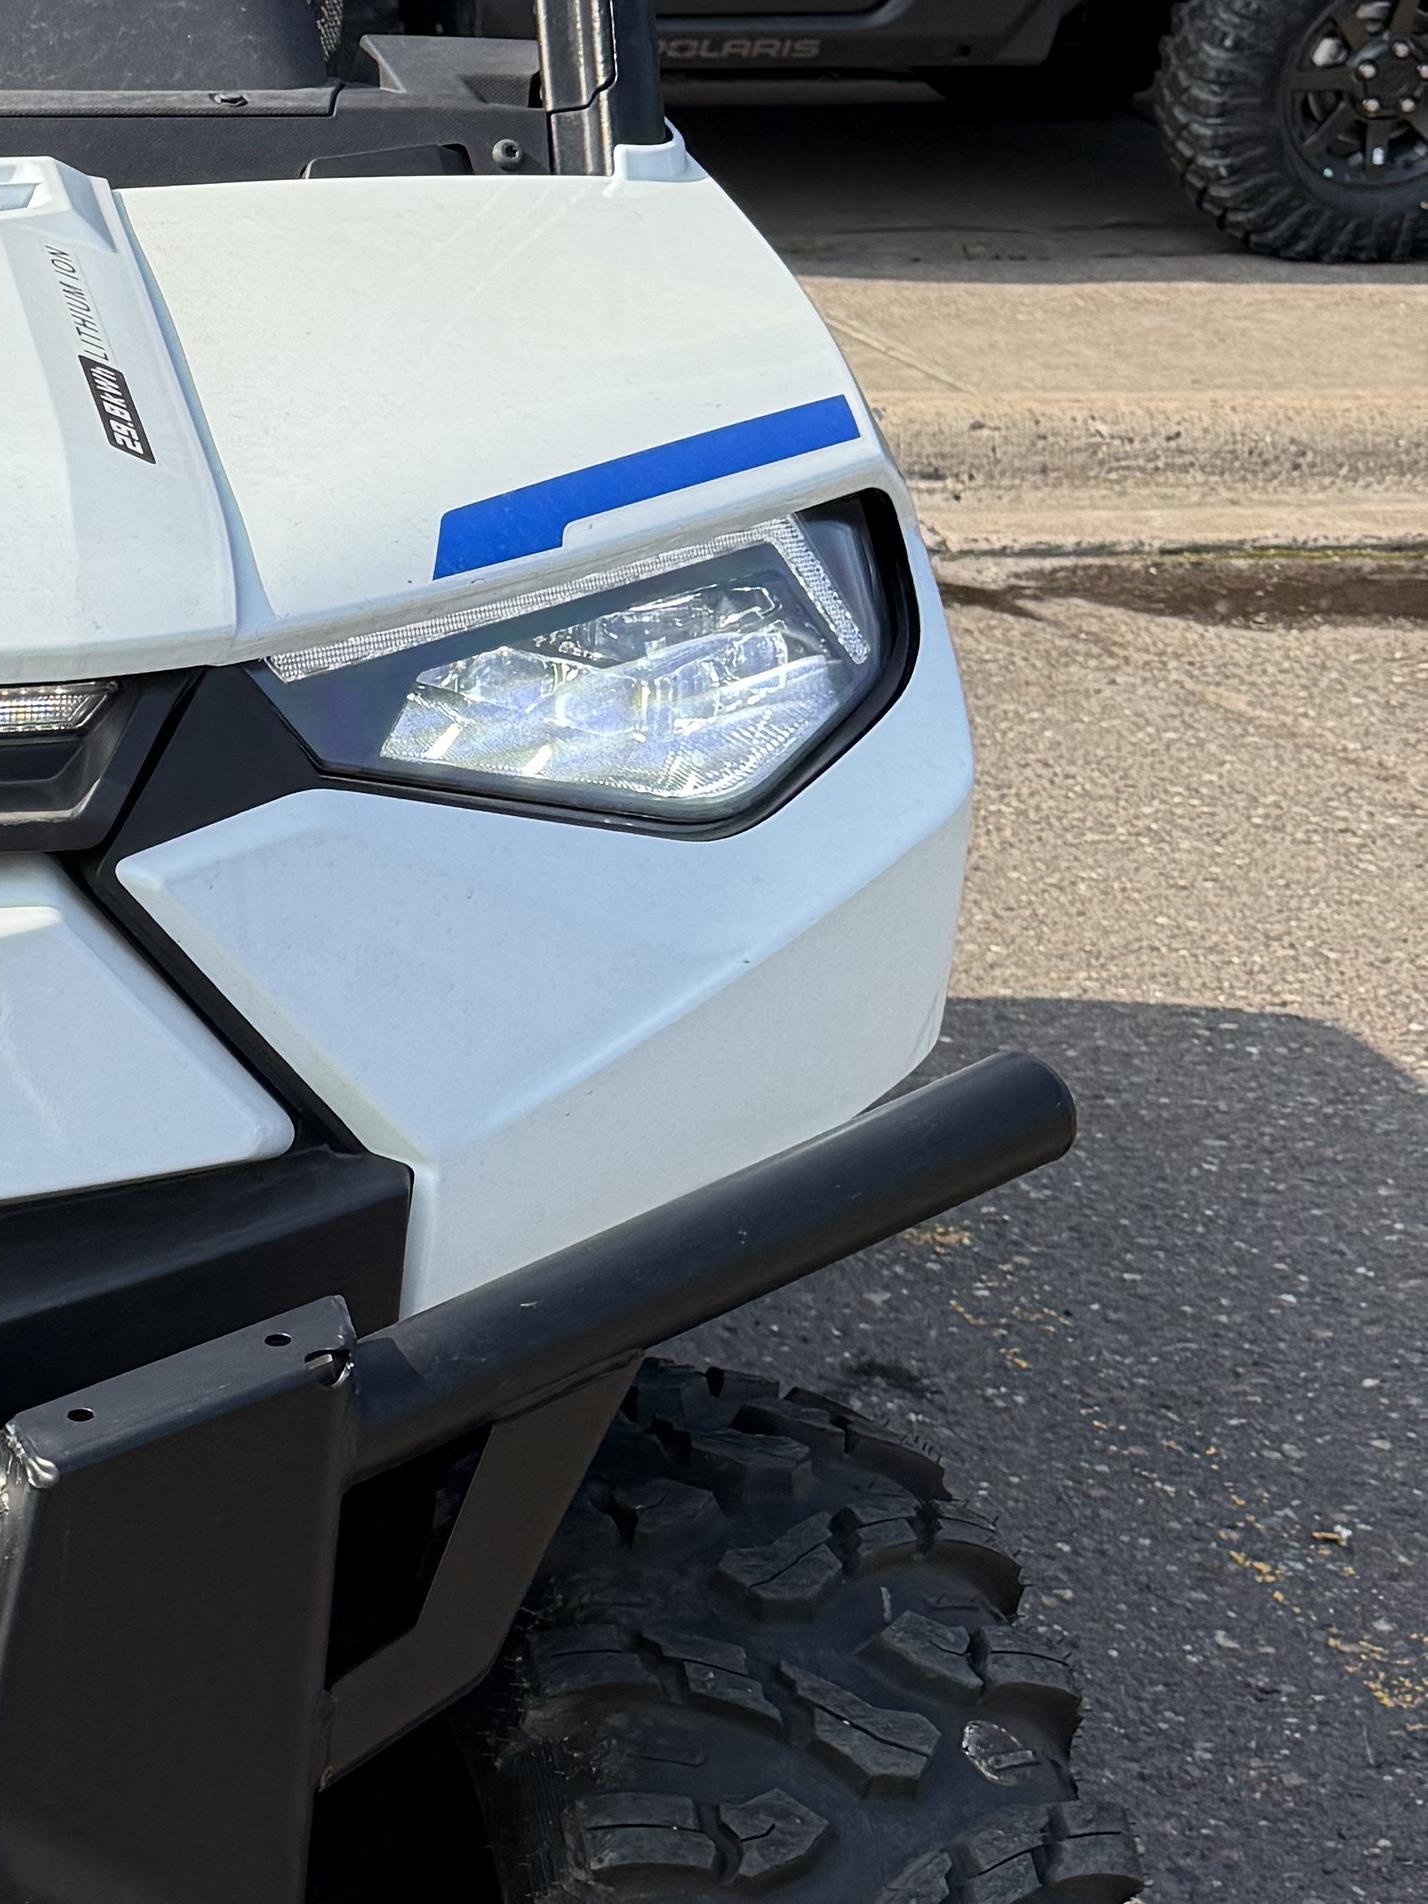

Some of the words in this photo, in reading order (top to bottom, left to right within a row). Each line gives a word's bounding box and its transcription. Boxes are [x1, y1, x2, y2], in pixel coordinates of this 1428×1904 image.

[44, 244, 80, 281] ION
[58, 281, 110, 362] LITHIUM
[89, 365, 145, 455] 29.8kWh
